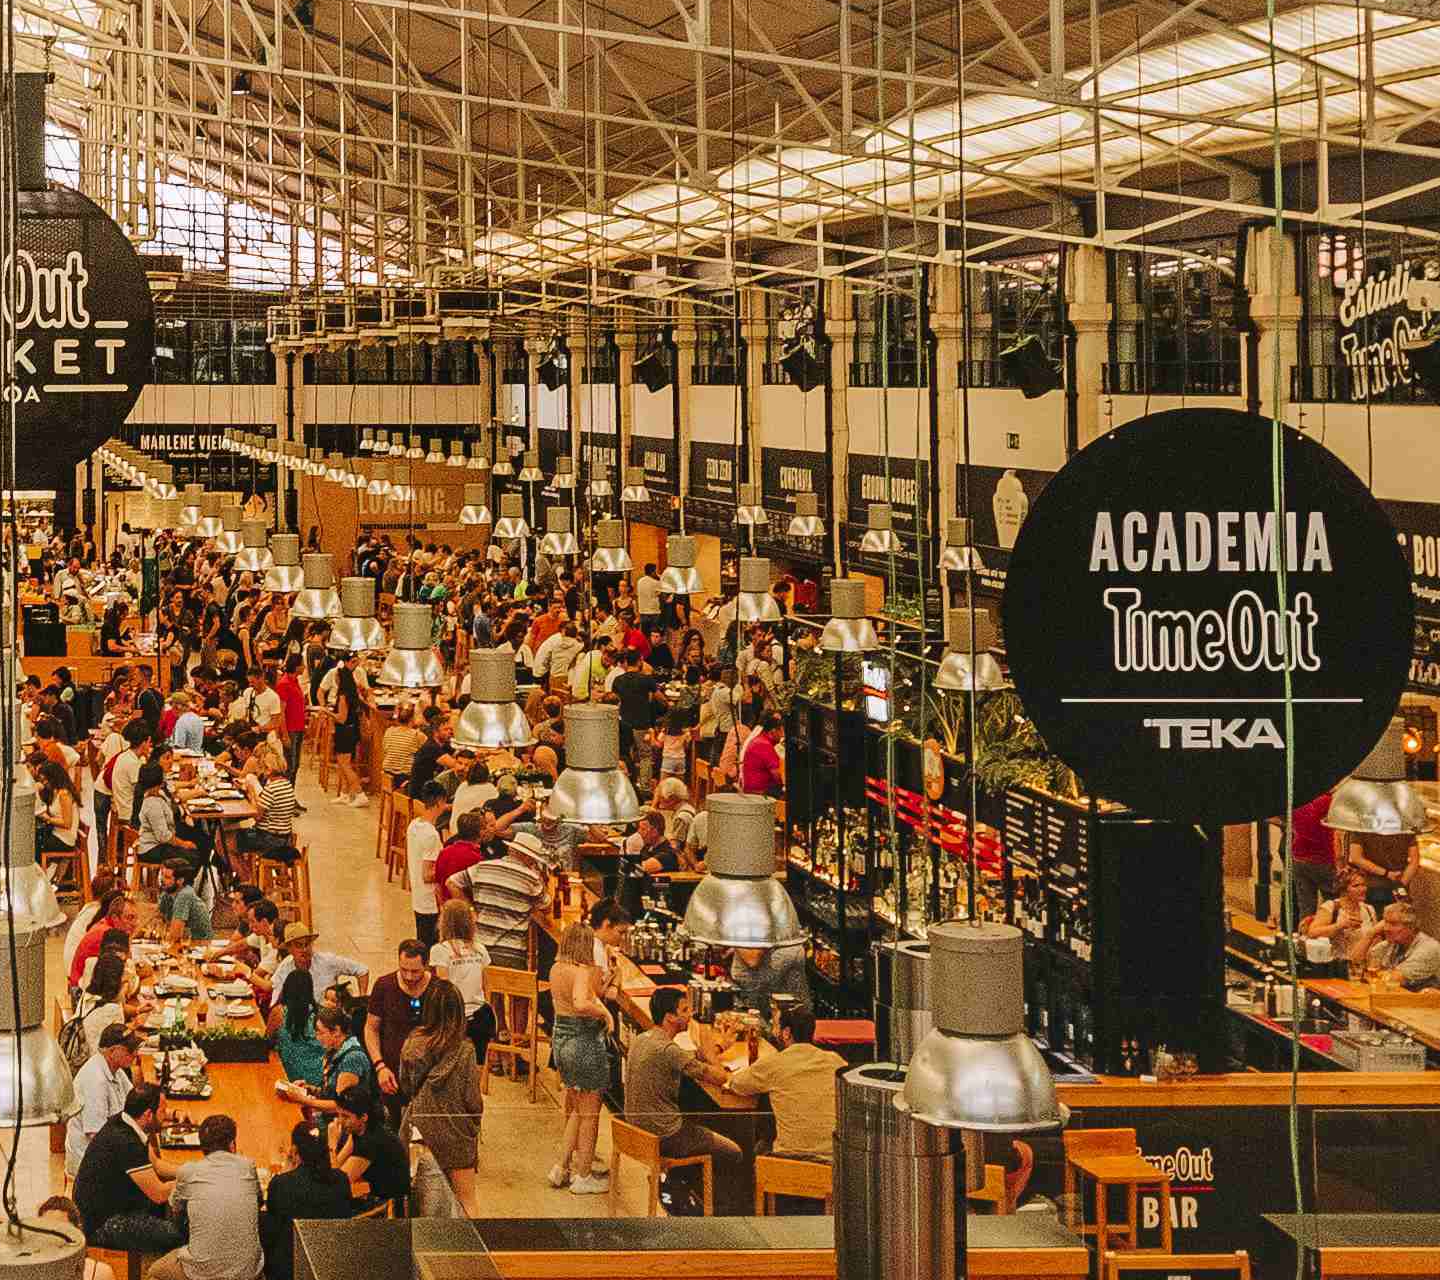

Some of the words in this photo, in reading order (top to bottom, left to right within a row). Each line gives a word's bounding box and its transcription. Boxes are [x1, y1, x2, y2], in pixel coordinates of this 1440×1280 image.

[1339, 259, 1413, 327] Estúdi
[140, 434, 195, 450] MARLENE
[1089, 511, 1333, 572] ACADEMIA
[1144, 718, 1286, 749] TEKA
[1143, 1196, 1199, 1229] BAR
